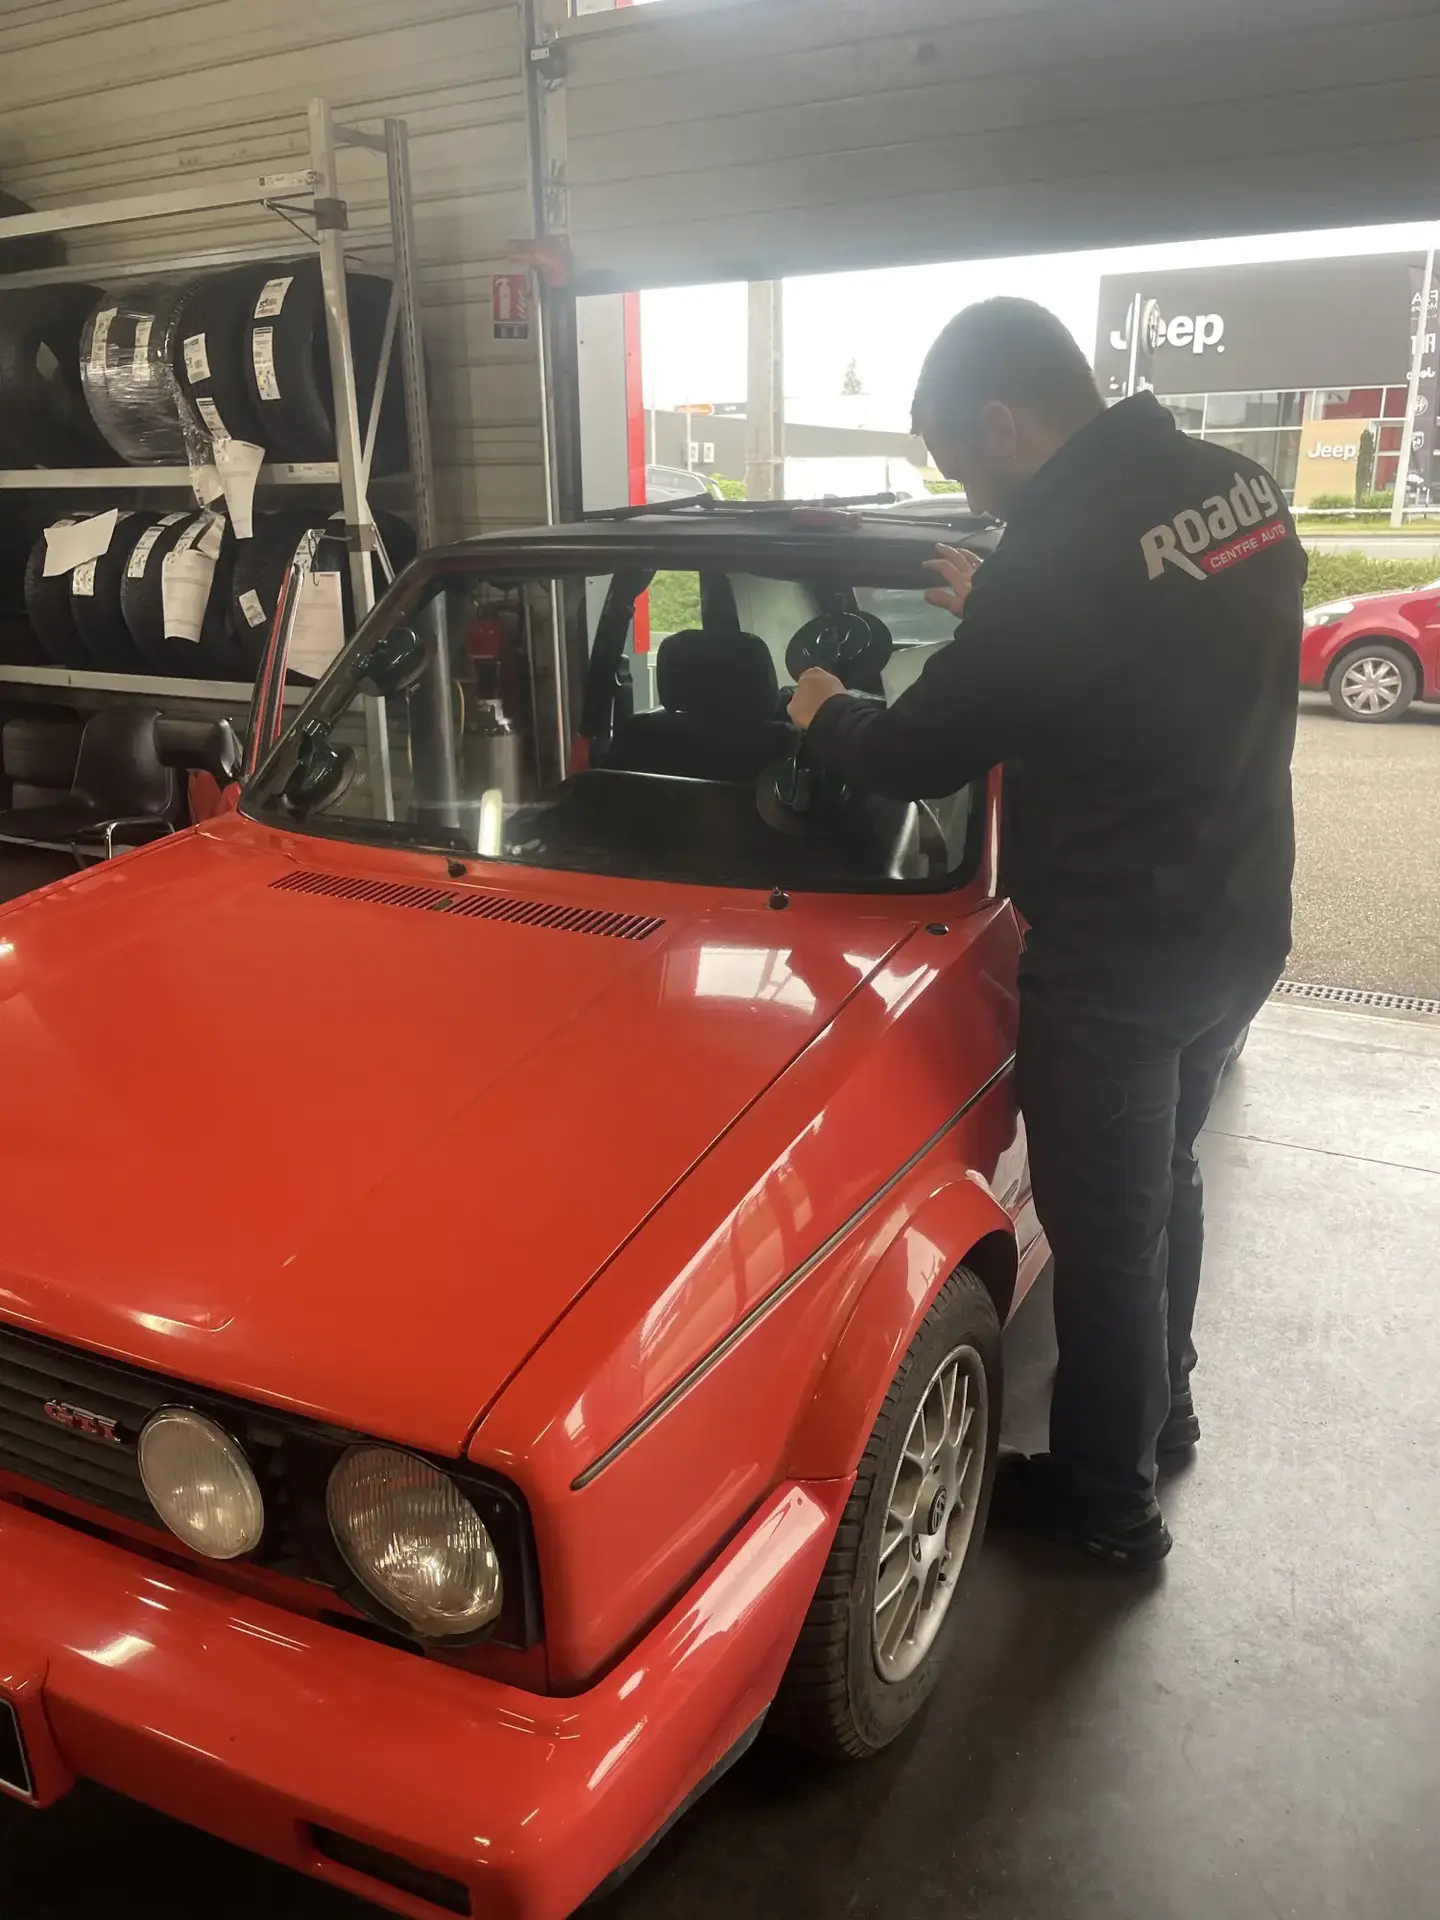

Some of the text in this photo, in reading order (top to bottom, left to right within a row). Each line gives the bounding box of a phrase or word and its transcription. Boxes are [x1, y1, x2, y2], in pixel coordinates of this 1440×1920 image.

[1308, 441, 1357, 461] Jeep
[1139, 472, 1279, 580] Roady
[1210, 523, 1286, 569] CENTRE AUTO
[44, 1399, 120, 1442] GTI
